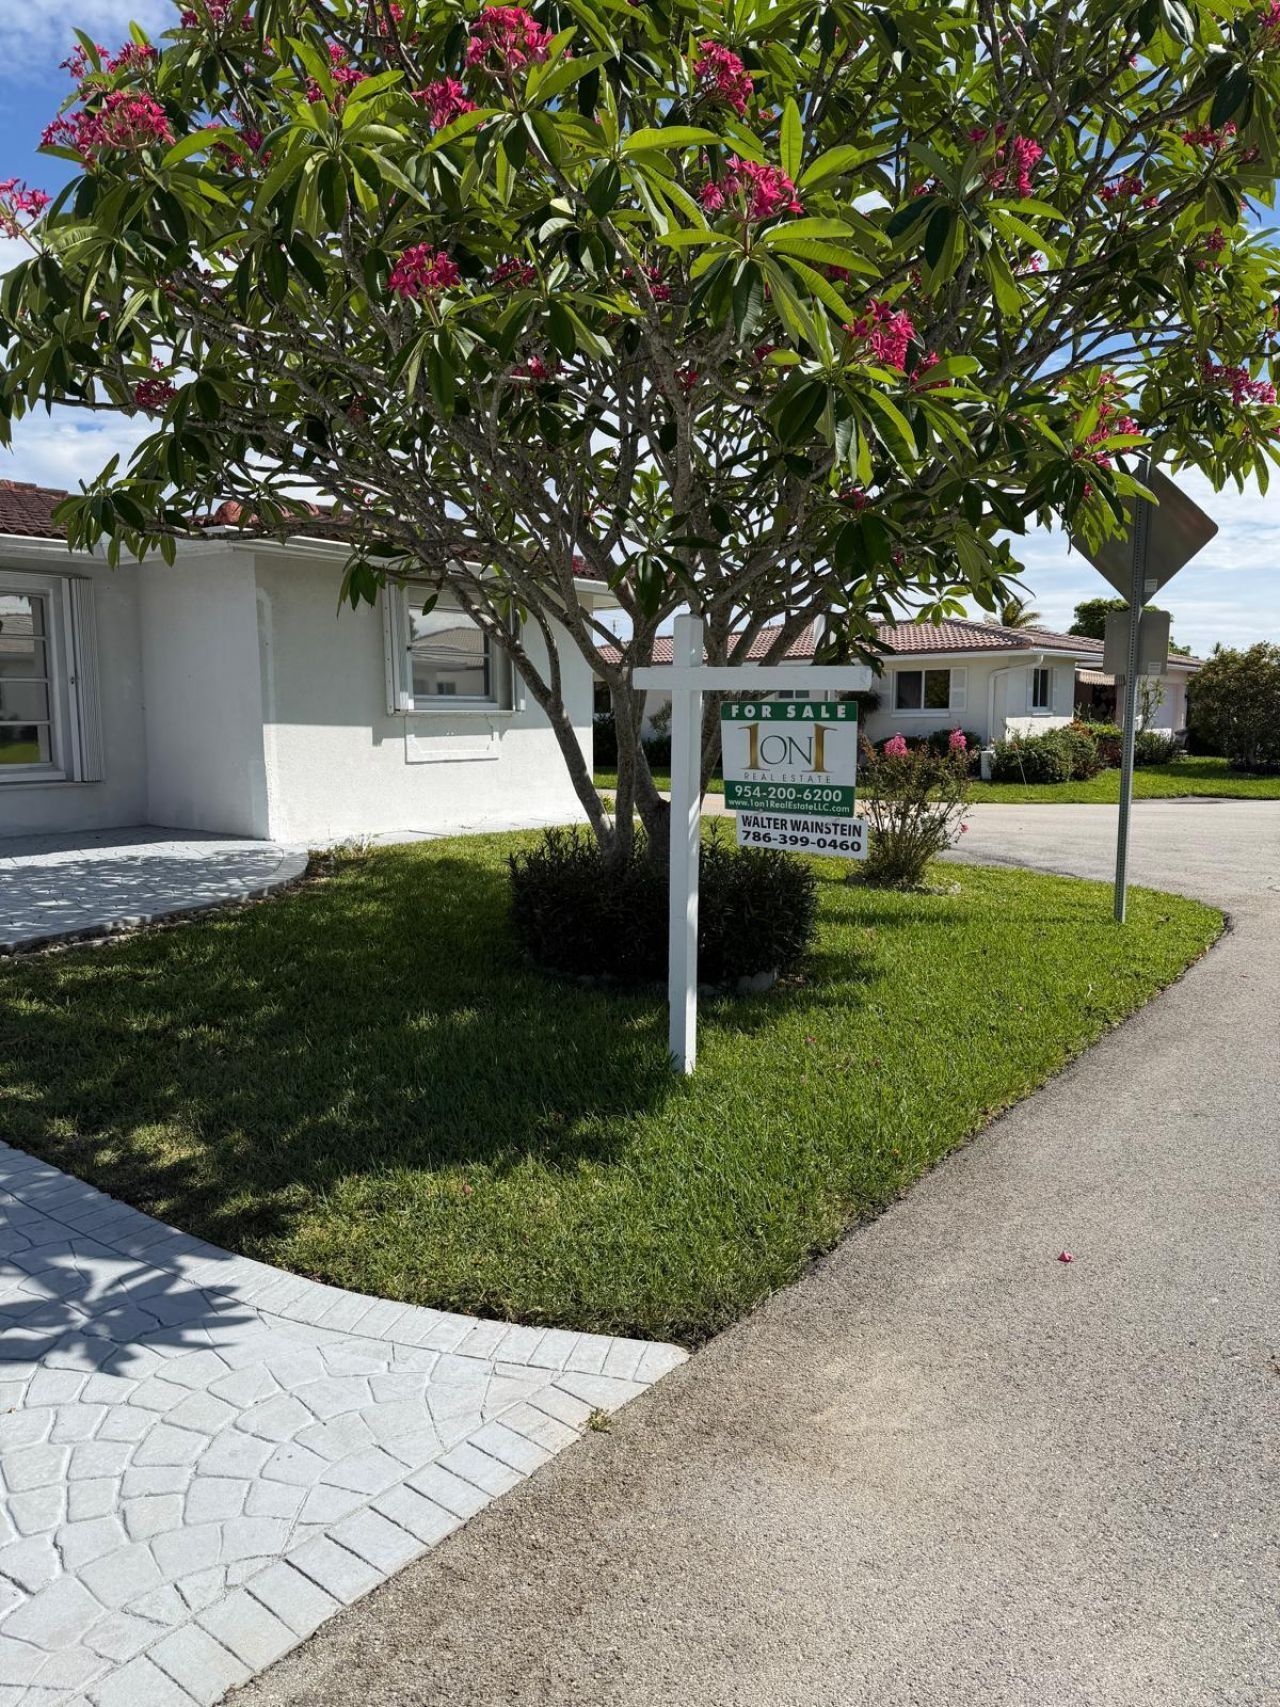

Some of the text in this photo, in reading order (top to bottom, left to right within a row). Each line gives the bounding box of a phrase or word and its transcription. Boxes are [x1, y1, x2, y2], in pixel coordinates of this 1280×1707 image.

[731, 705, 846, 718] FOR SALE
[744, 772, 832, 784] REAL ESTATE
[735, 785, 842, 802] 954-200-6200
[728, 799, 850, 813] www.1on1RealEstateLLC.com
[742, 815, 862, 837] WALTER WAINSTEIN
[742, 831, 862, 852] 786-399-0460
